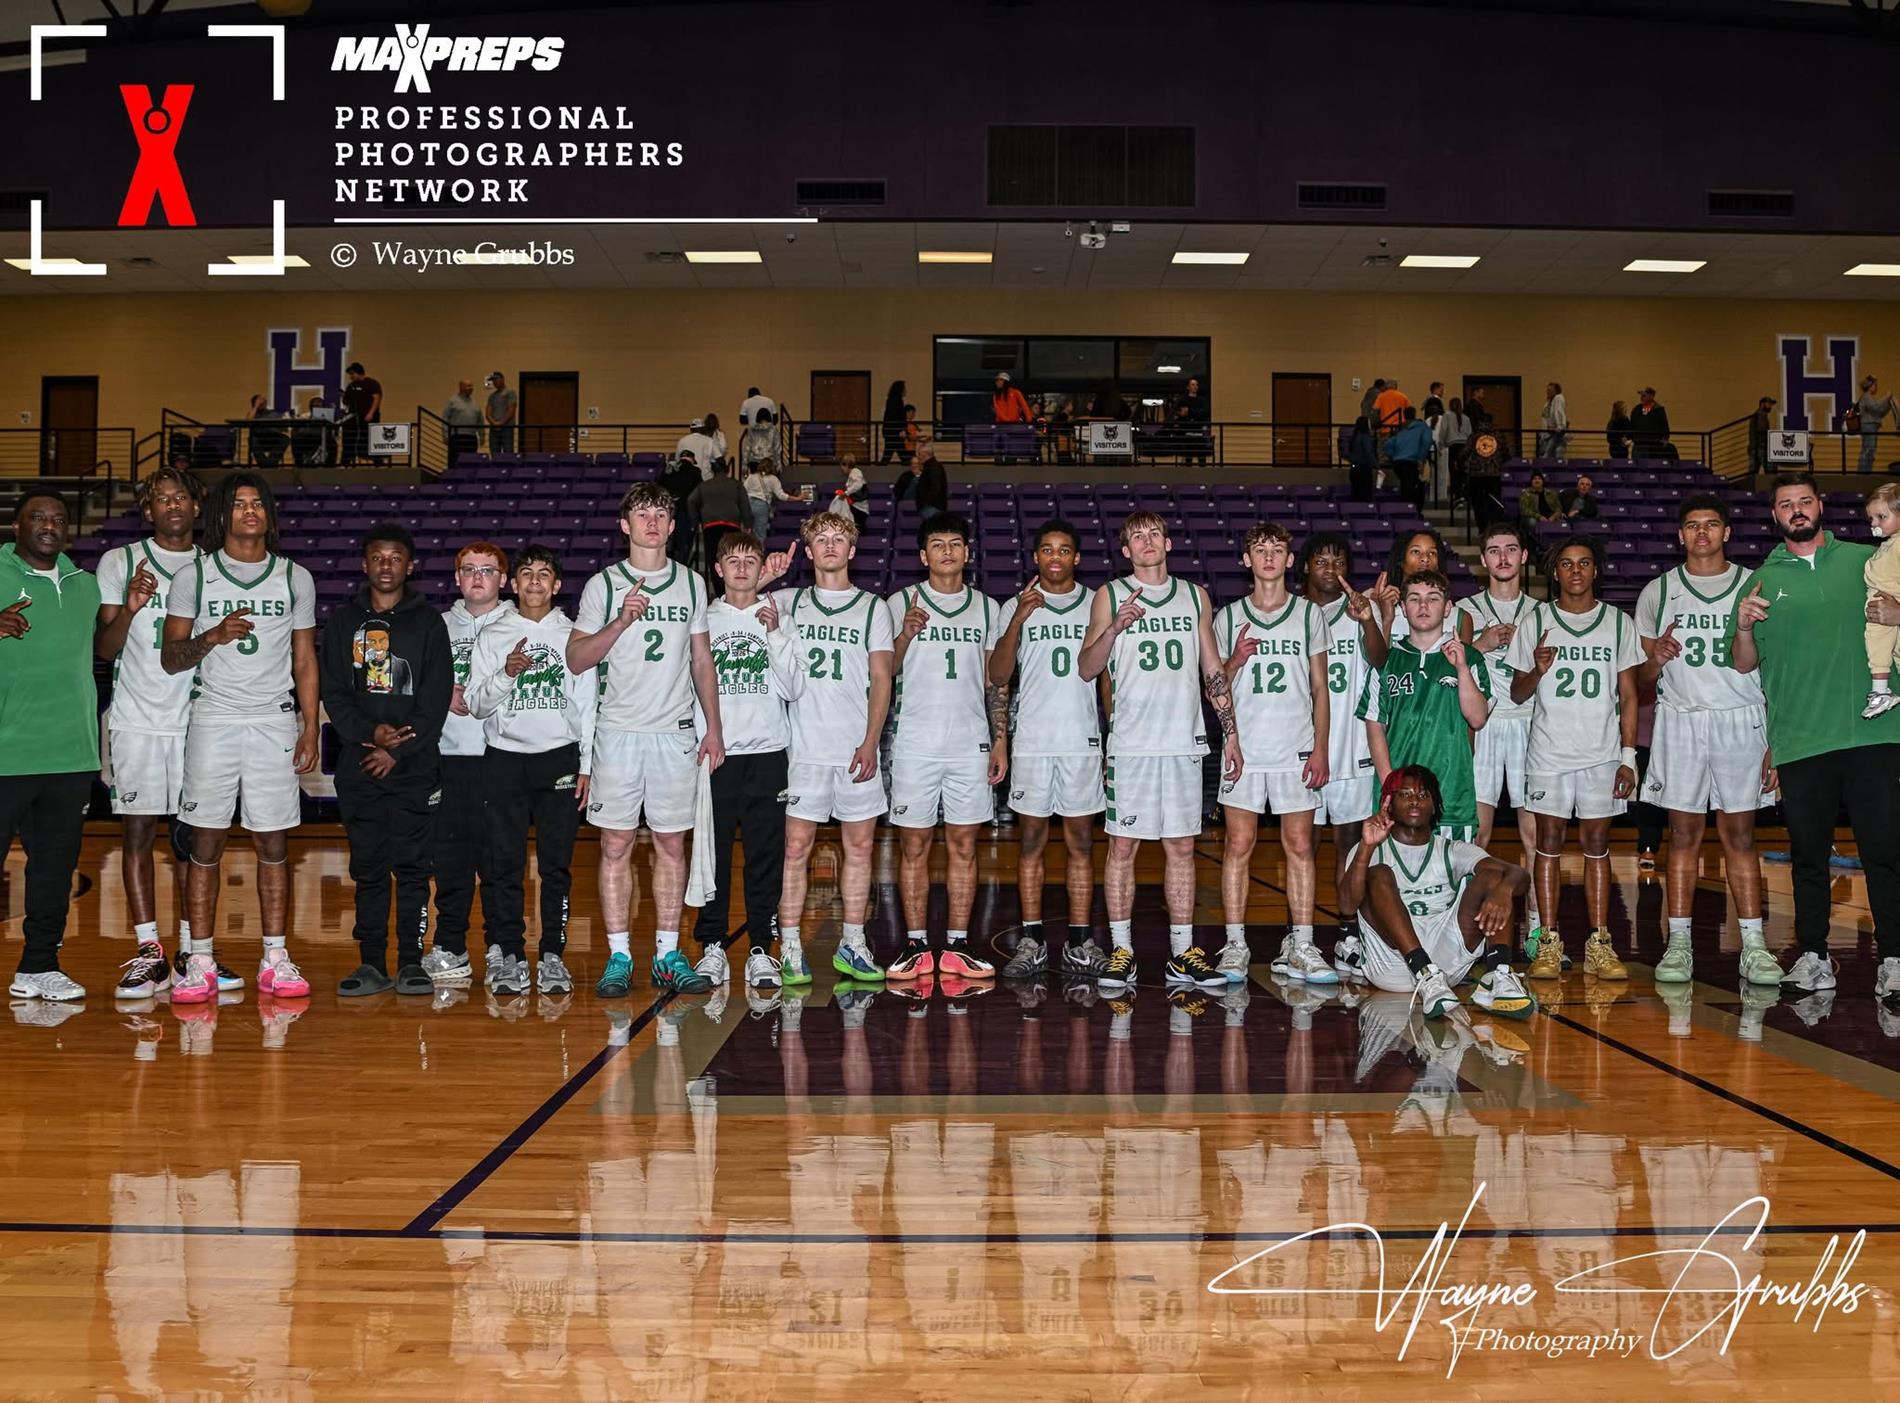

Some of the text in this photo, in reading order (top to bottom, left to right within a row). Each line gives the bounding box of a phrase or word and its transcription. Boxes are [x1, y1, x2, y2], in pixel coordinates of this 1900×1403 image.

[267, 328, 350, 412] H
[1778, 336, 1859, 437] H
[373, 442, 405, 450] VISITORS
[1773, 449, 1804, 457] VISITORS
[617, 605, 688, 622] GLES
[644, 629, 665, 662] 2
[918, 626, 982, 644] EAGLES
[1028, 624, 1089, 642] EAGLE
[1138, 639, 1183, 671] 30
[1257, 639, 1301, 656] GLES
[1556, 645, 1612, 662] AGLES
[1684, 637, 1729, 667] 35
[808, 647, 843, 680] 21
[945, 648, 957, 679] 1
[1051, 646, 1071, 677] 0
[719, 682, 769, 695] AGLES
[721, 672, 765, 685] ATUM
[1252, 662, 1287, 694] 12
[1387, 672, 1415, 697] 24
[1555, 667, 1602, 699] 20
